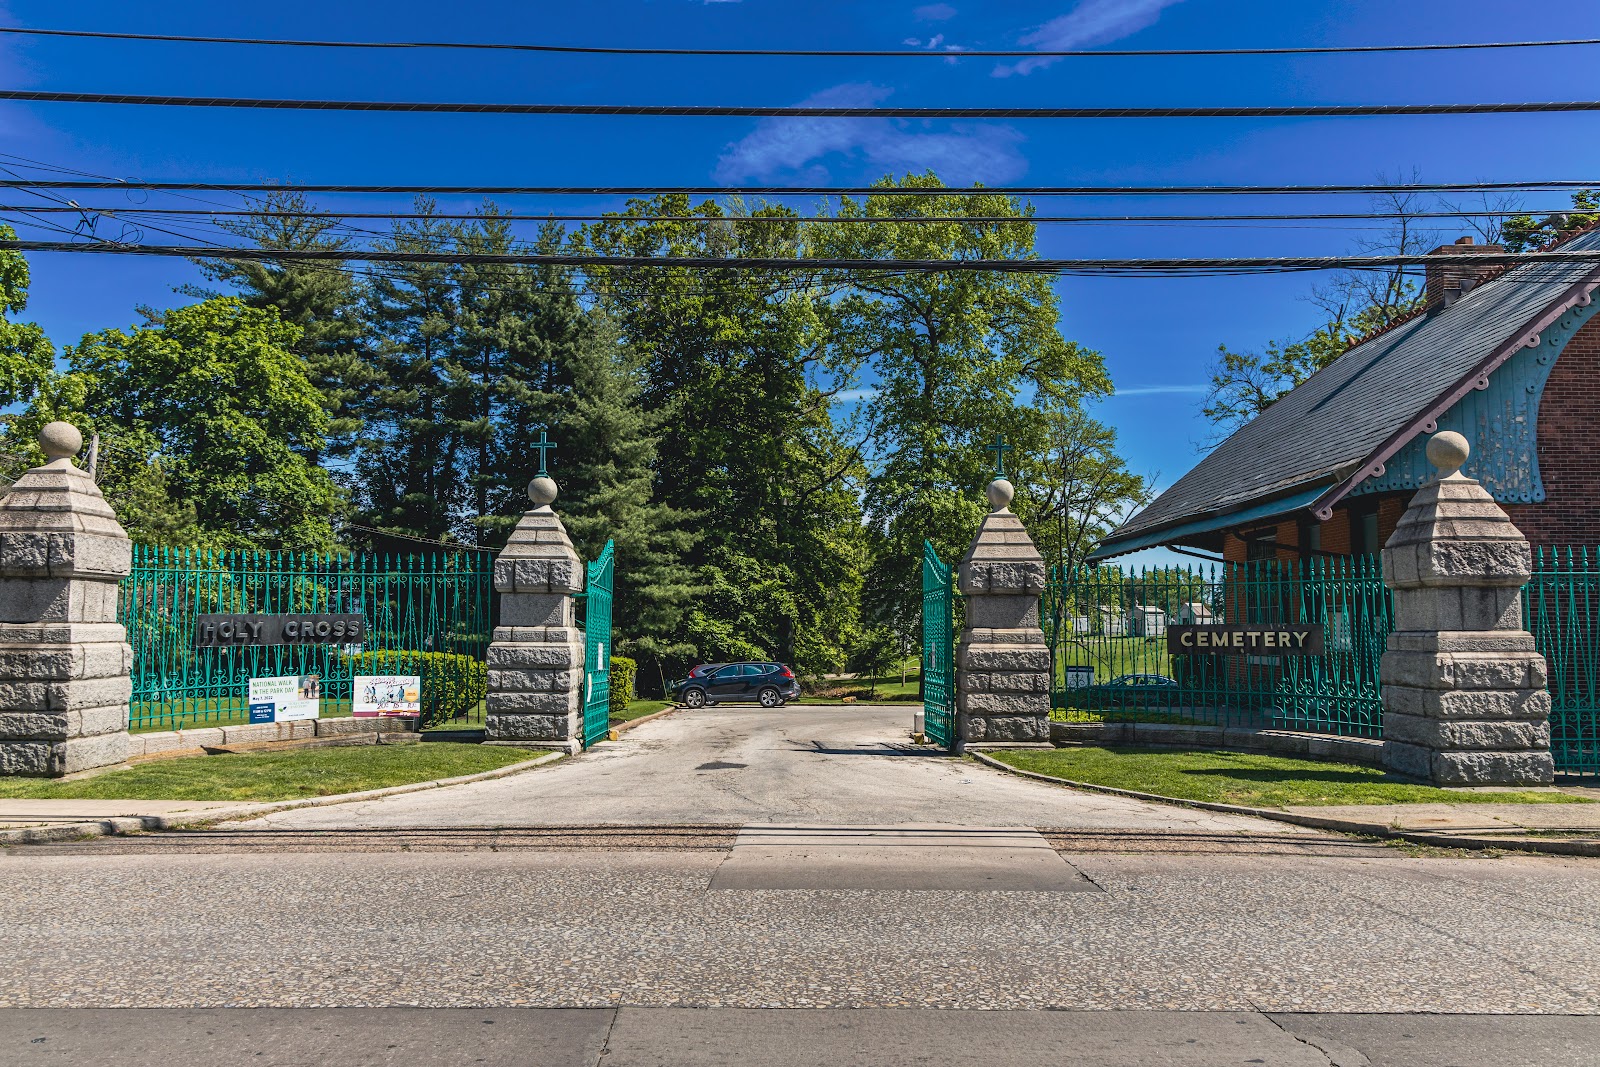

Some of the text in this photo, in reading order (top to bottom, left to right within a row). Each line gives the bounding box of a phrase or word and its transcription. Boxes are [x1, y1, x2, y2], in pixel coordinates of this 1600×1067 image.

[201, 620, 360, 638] HOLY CROSS
[1180, 631, 1309, 647] CEMETERY
